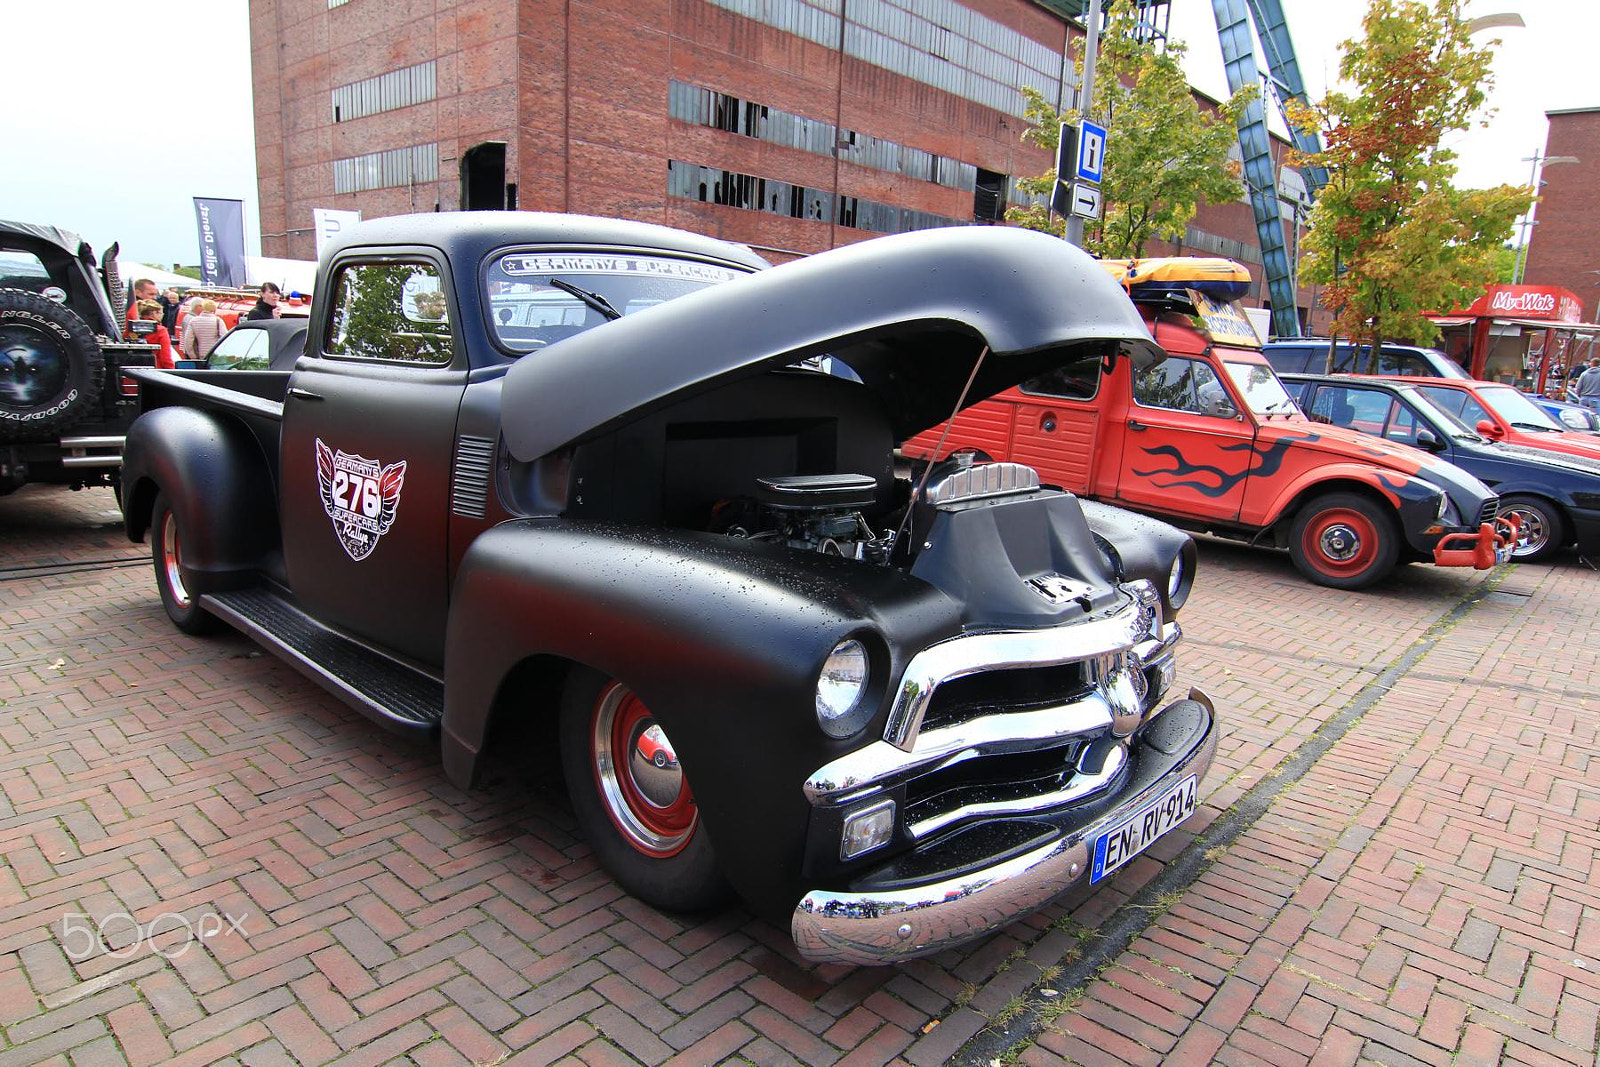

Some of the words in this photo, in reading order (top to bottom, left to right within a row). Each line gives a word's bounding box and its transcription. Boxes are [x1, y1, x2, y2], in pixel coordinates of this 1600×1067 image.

[1519, 292, 1555, 311] Wok
[334, 470, 379, 518] 276
[1104, 823, 1134, 871] EN
